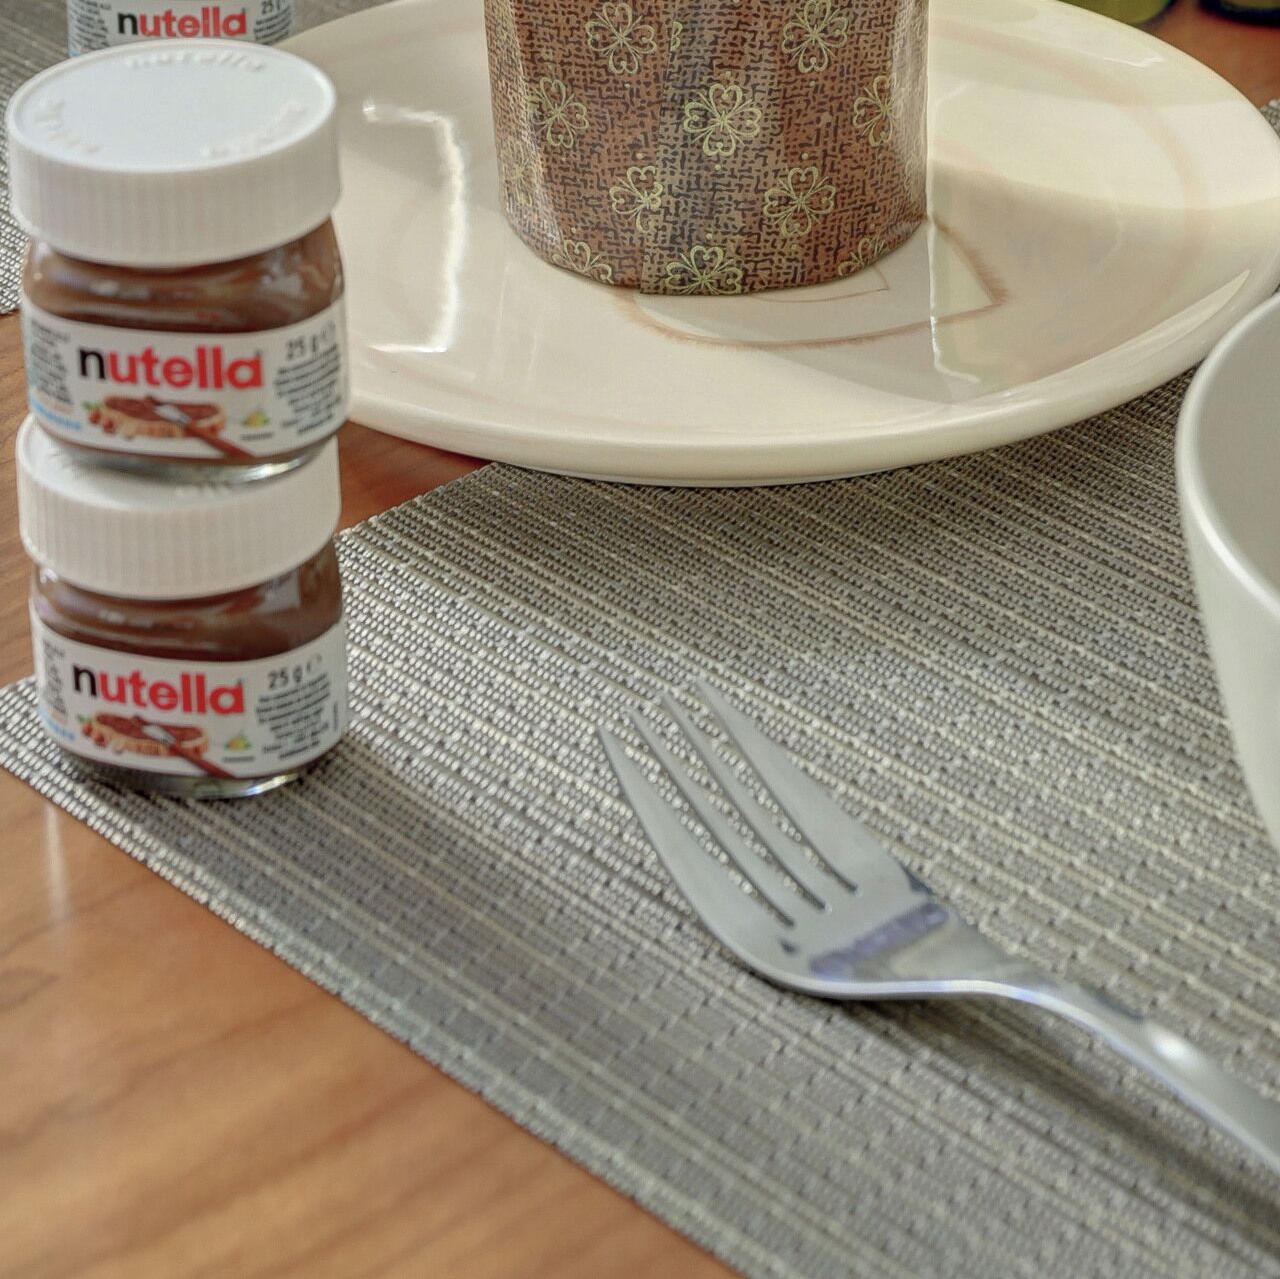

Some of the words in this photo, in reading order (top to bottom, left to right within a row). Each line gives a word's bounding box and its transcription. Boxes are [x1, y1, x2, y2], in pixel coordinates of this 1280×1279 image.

[117, 6, 248, 39] nutella
[79, 345, 263, 391] nutella
[73, 663, 247, 715] nutella
